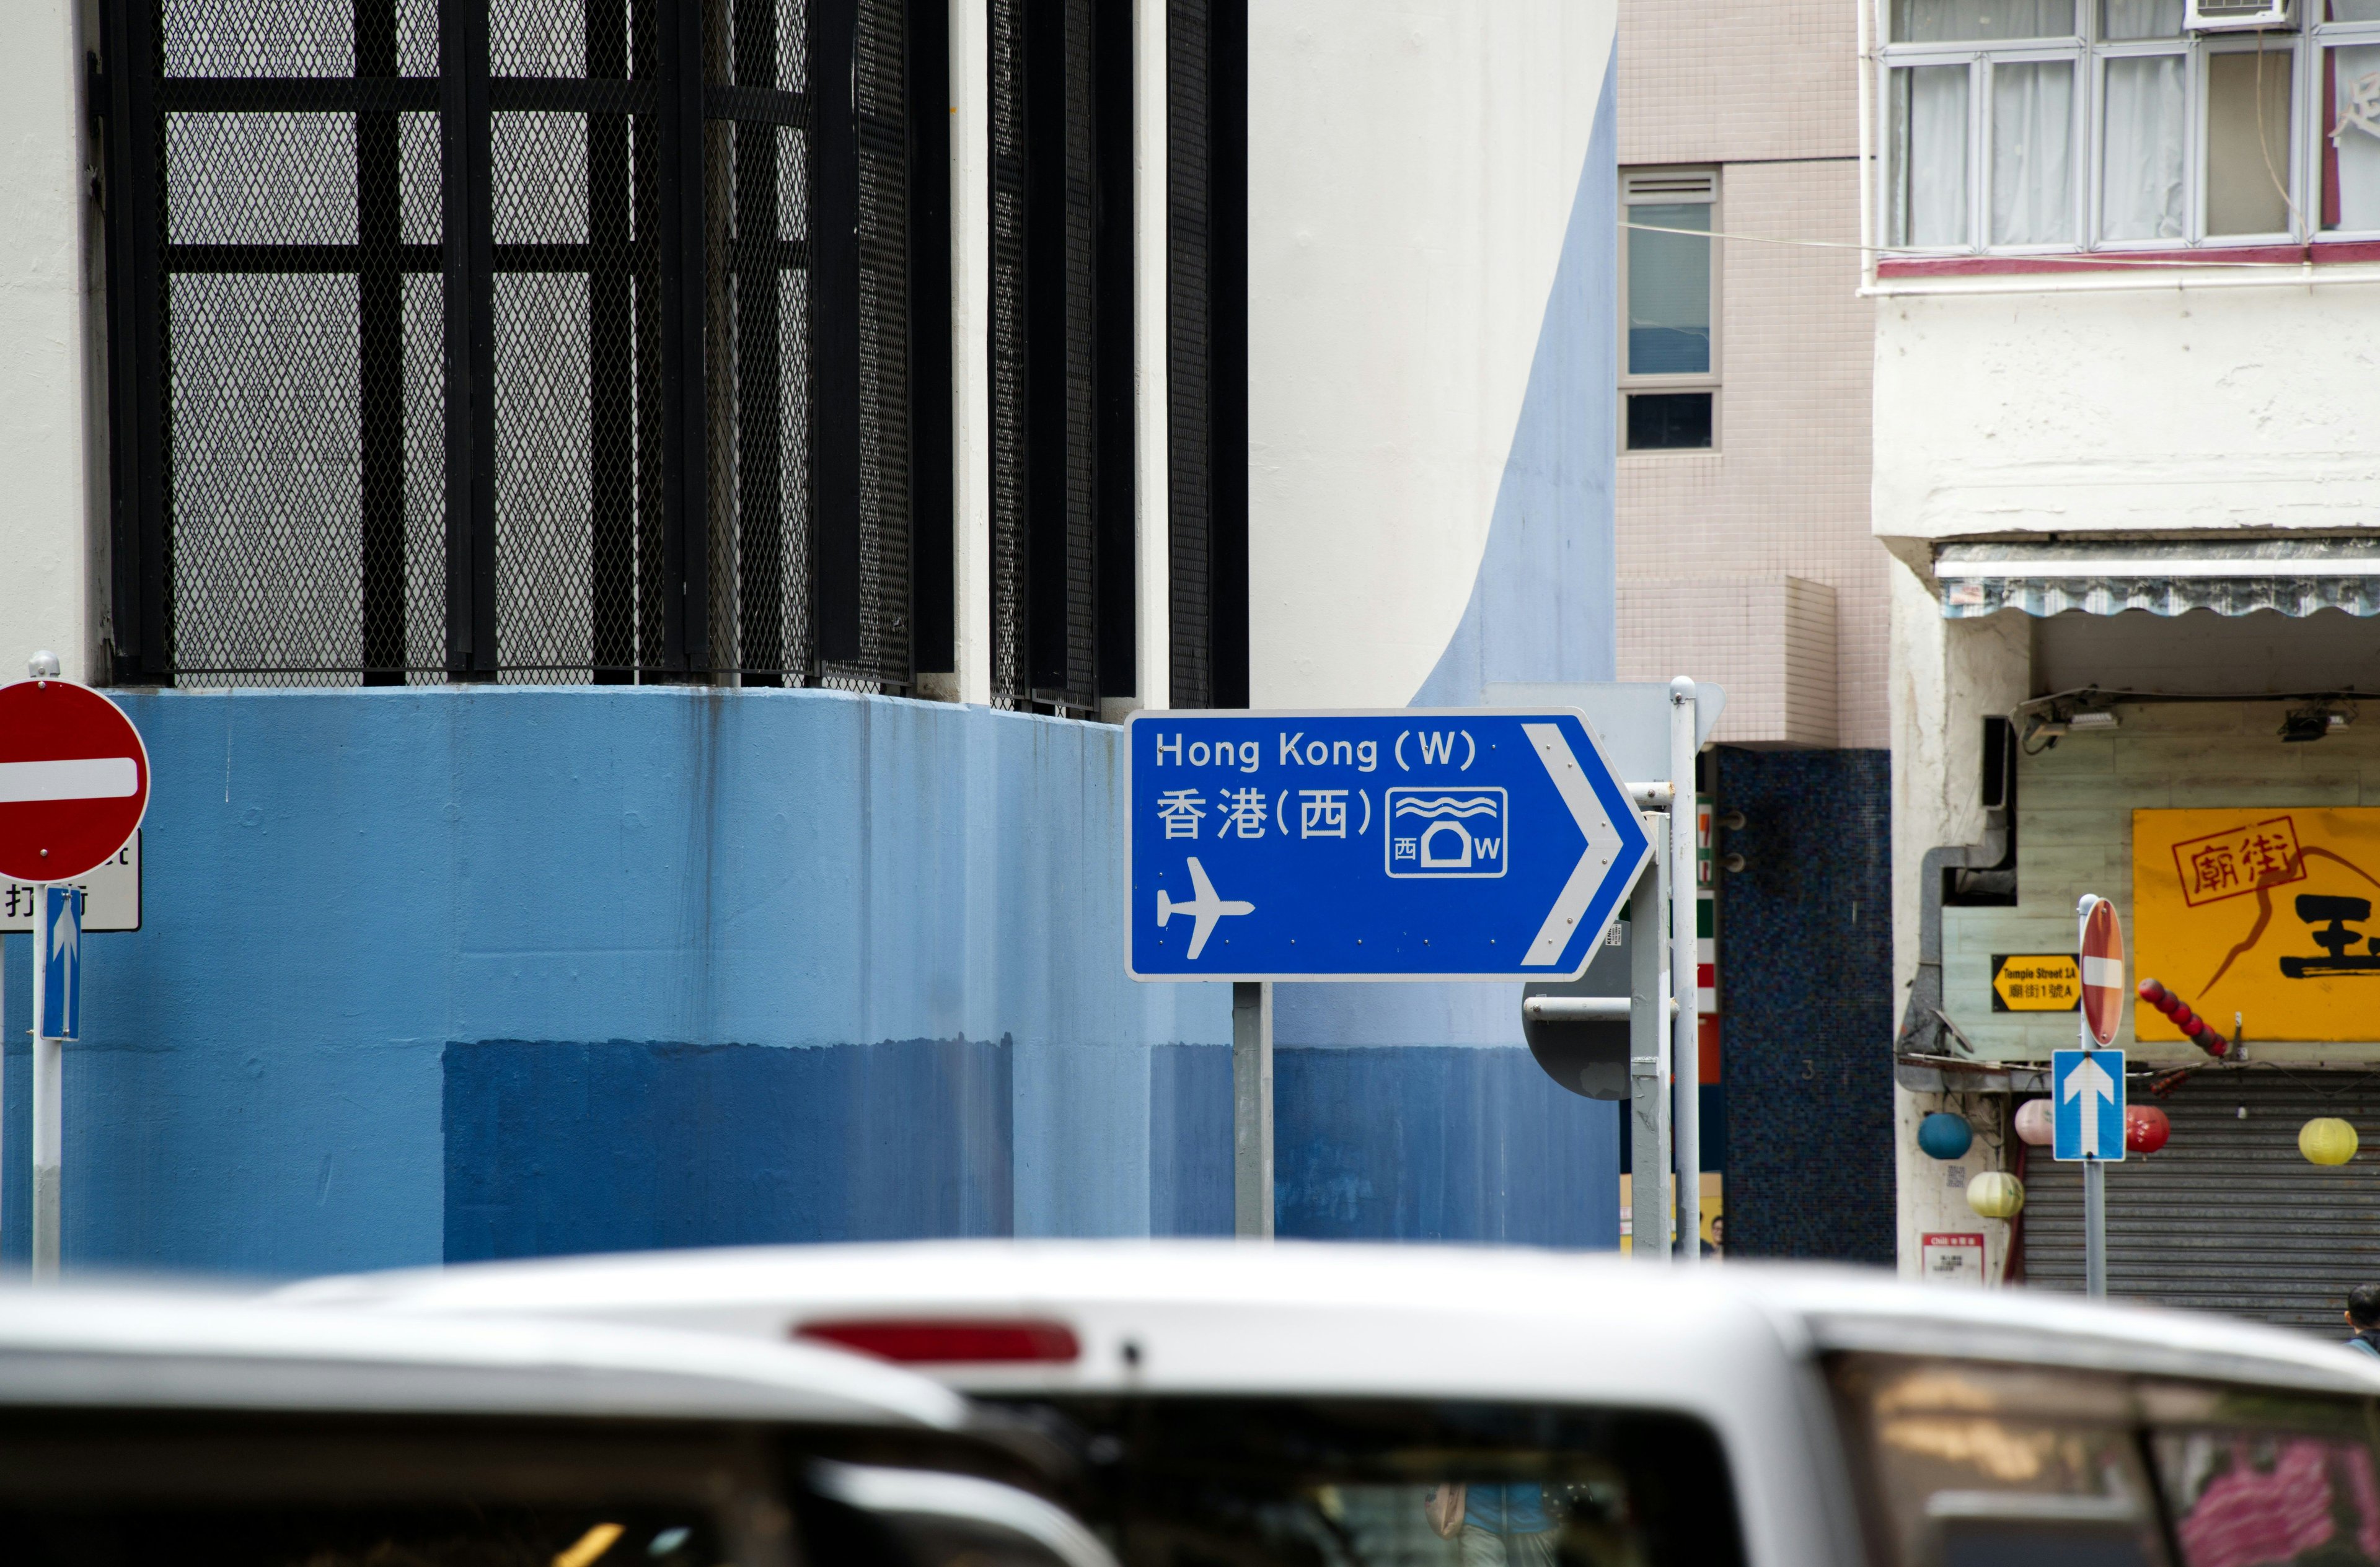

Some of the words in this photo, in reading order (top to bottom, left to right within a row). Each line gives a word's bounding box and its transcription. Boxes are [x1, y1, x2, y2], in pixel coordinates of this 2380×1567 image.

[1157, 733, 1260, 773] Hong
[1280, 733, 1377, 773] Kong
[1395, 730, 1475, 771] (W)
[1157, 788, 1371, 840] 香港(西)
[1395, 838, 1417, 860] 西
[1474, 838, 1500, 859] W
[2190, 834, 2293, 893] 廟街
[2004, 968, 2034, 981] Temple
[2035, 967, 2063, 979] Street
[2065, 967, 2076, 979] 1A
[2009, 984, 2073, 999] 廟街1號A
[1801, 1060, 1815, 1080] 3
